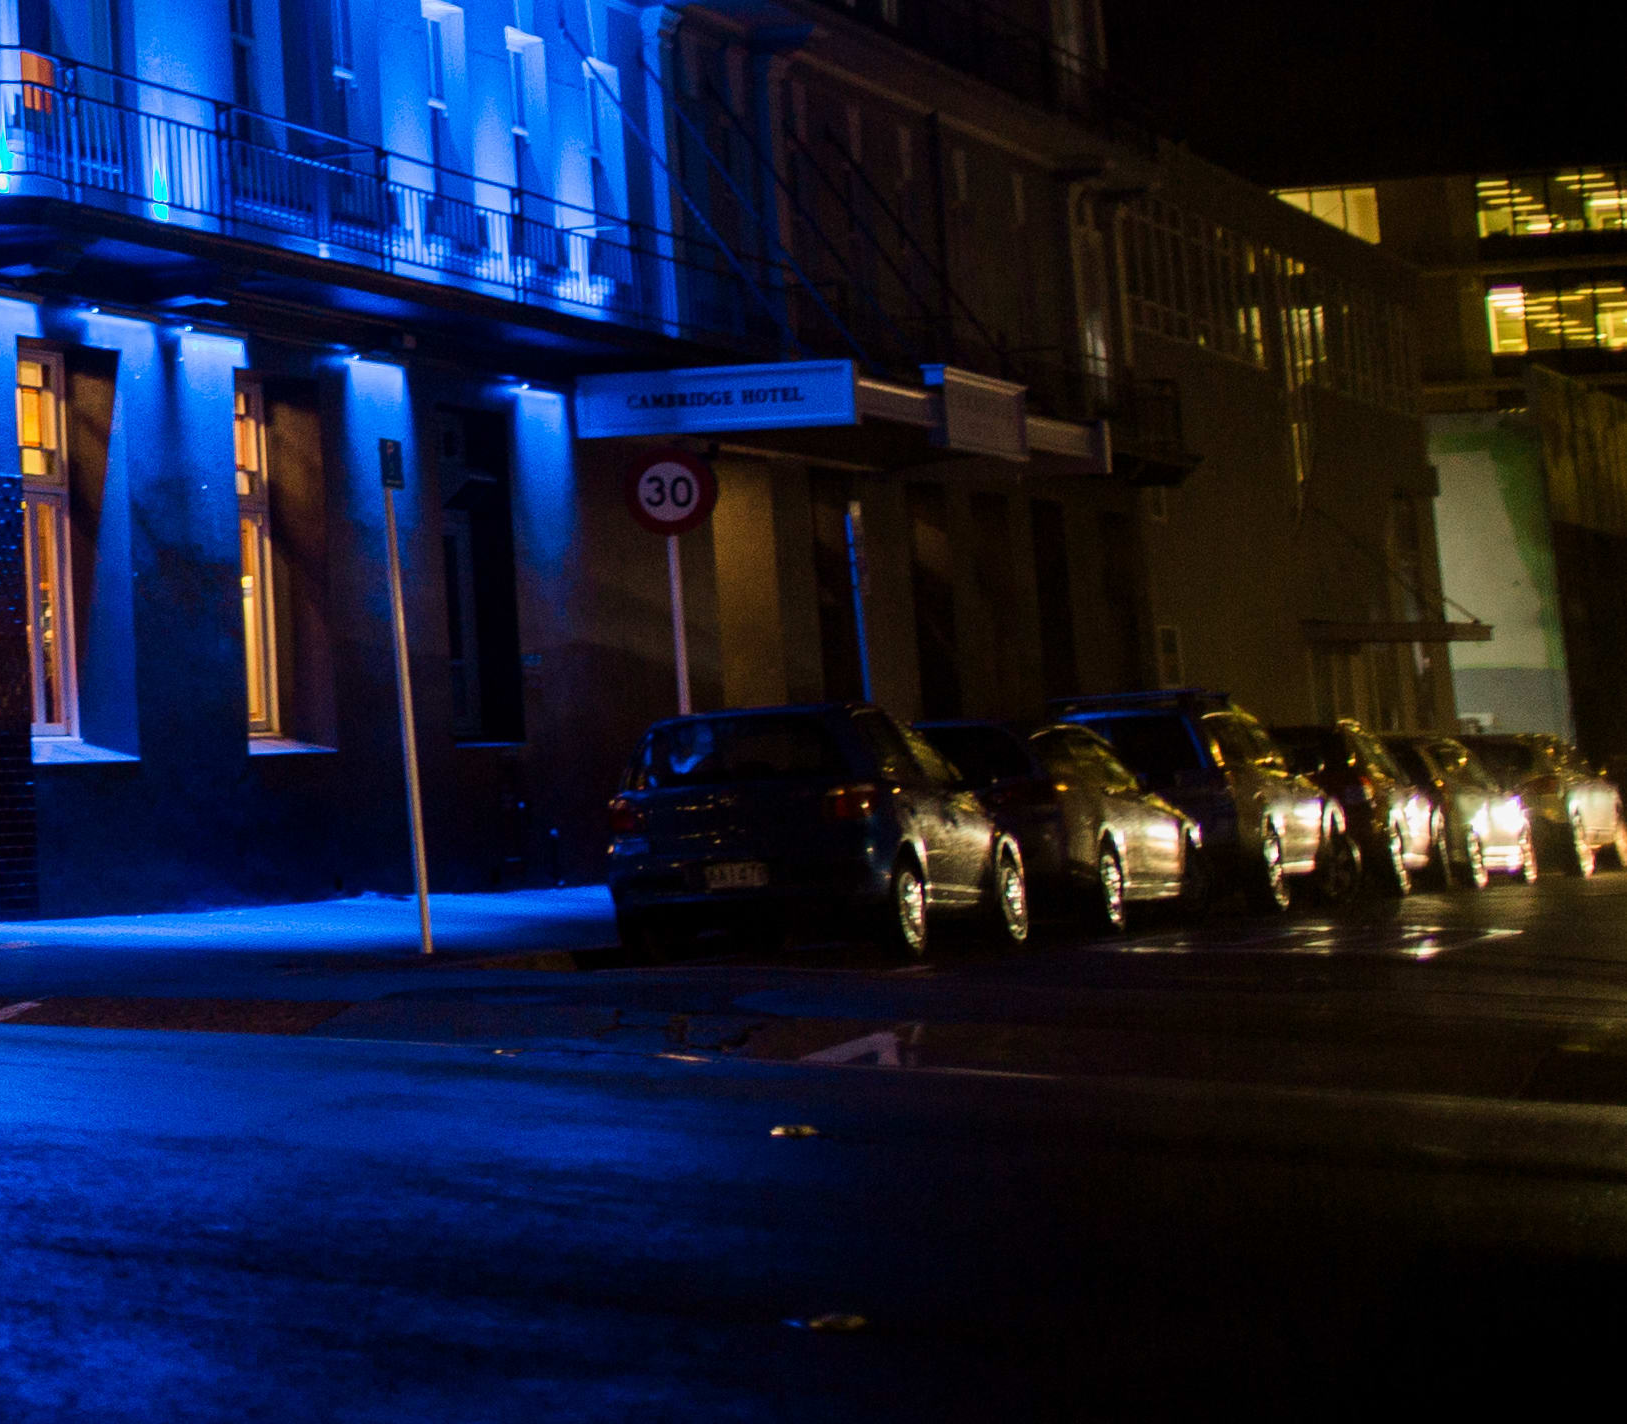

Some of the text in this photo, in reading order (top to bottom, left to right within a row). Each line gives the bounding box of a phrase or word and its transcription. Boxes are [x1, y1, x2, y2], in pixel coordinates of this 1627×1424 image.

[627, 387, 804, 409] CAMBRIDGE HOTEL
[646, 477, 692, 507] 30
